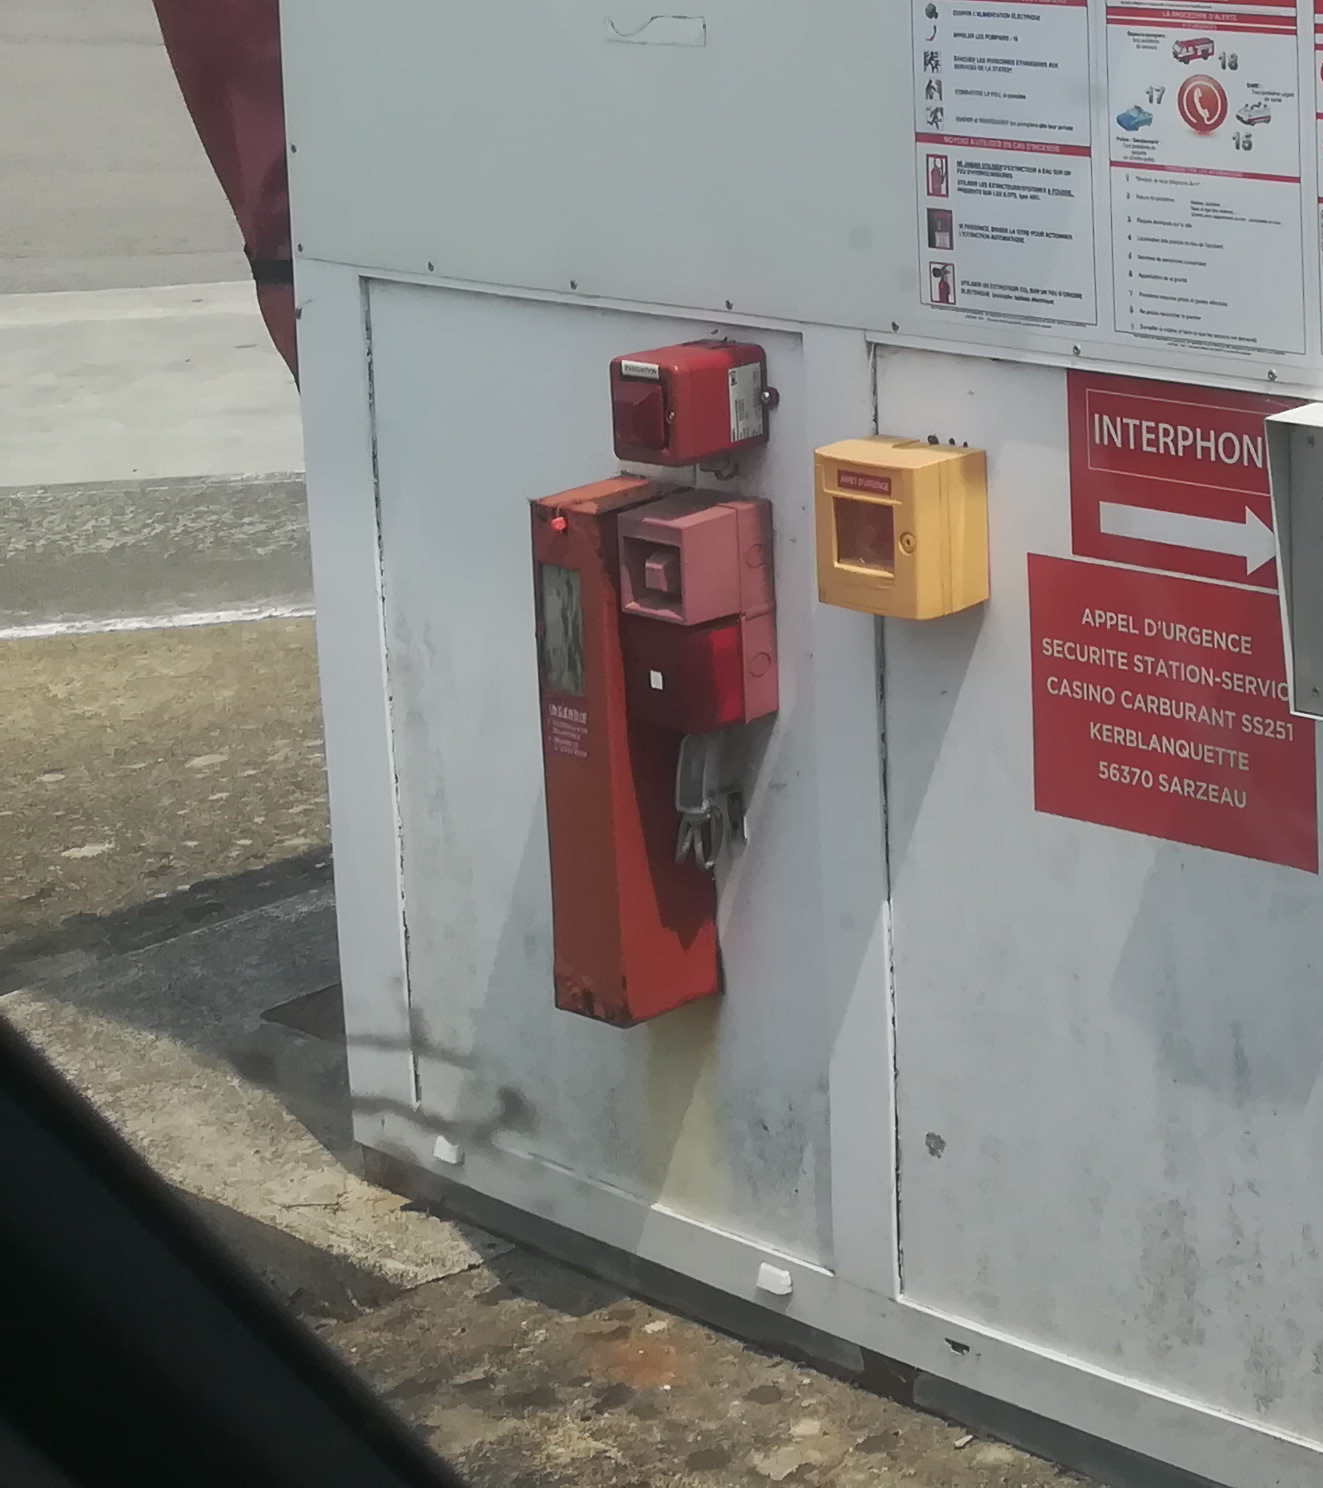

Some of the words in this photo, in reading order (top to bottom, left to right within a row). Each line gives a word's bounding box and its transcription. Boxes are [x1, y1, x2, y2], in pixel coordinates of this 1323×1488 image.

[1218, 51, 1238, 71] 18
[1145, 85, 1165, 104] 17
[1094, 413, 1263, 468] INTERPHON
[1081, 608, 1139, 635] APPEL
[1144, 618, 1252, 655] D'URGENCE
[1042, 638, 1128, 670] SECURITE
[1133, 655, 1290, 702] STATION-SERVIC
[1046, 676, 1115, 705] CASINO
[1120, 690, 1236, 729] CARBURANT
[1241, 714, 1295, 742] SS251
[1090, 721, 1250, 771] KERBLANQUETTE
[1098, 761, 1153, 789] 56370
[1158, 773, 1248, 809] SARZEAU
